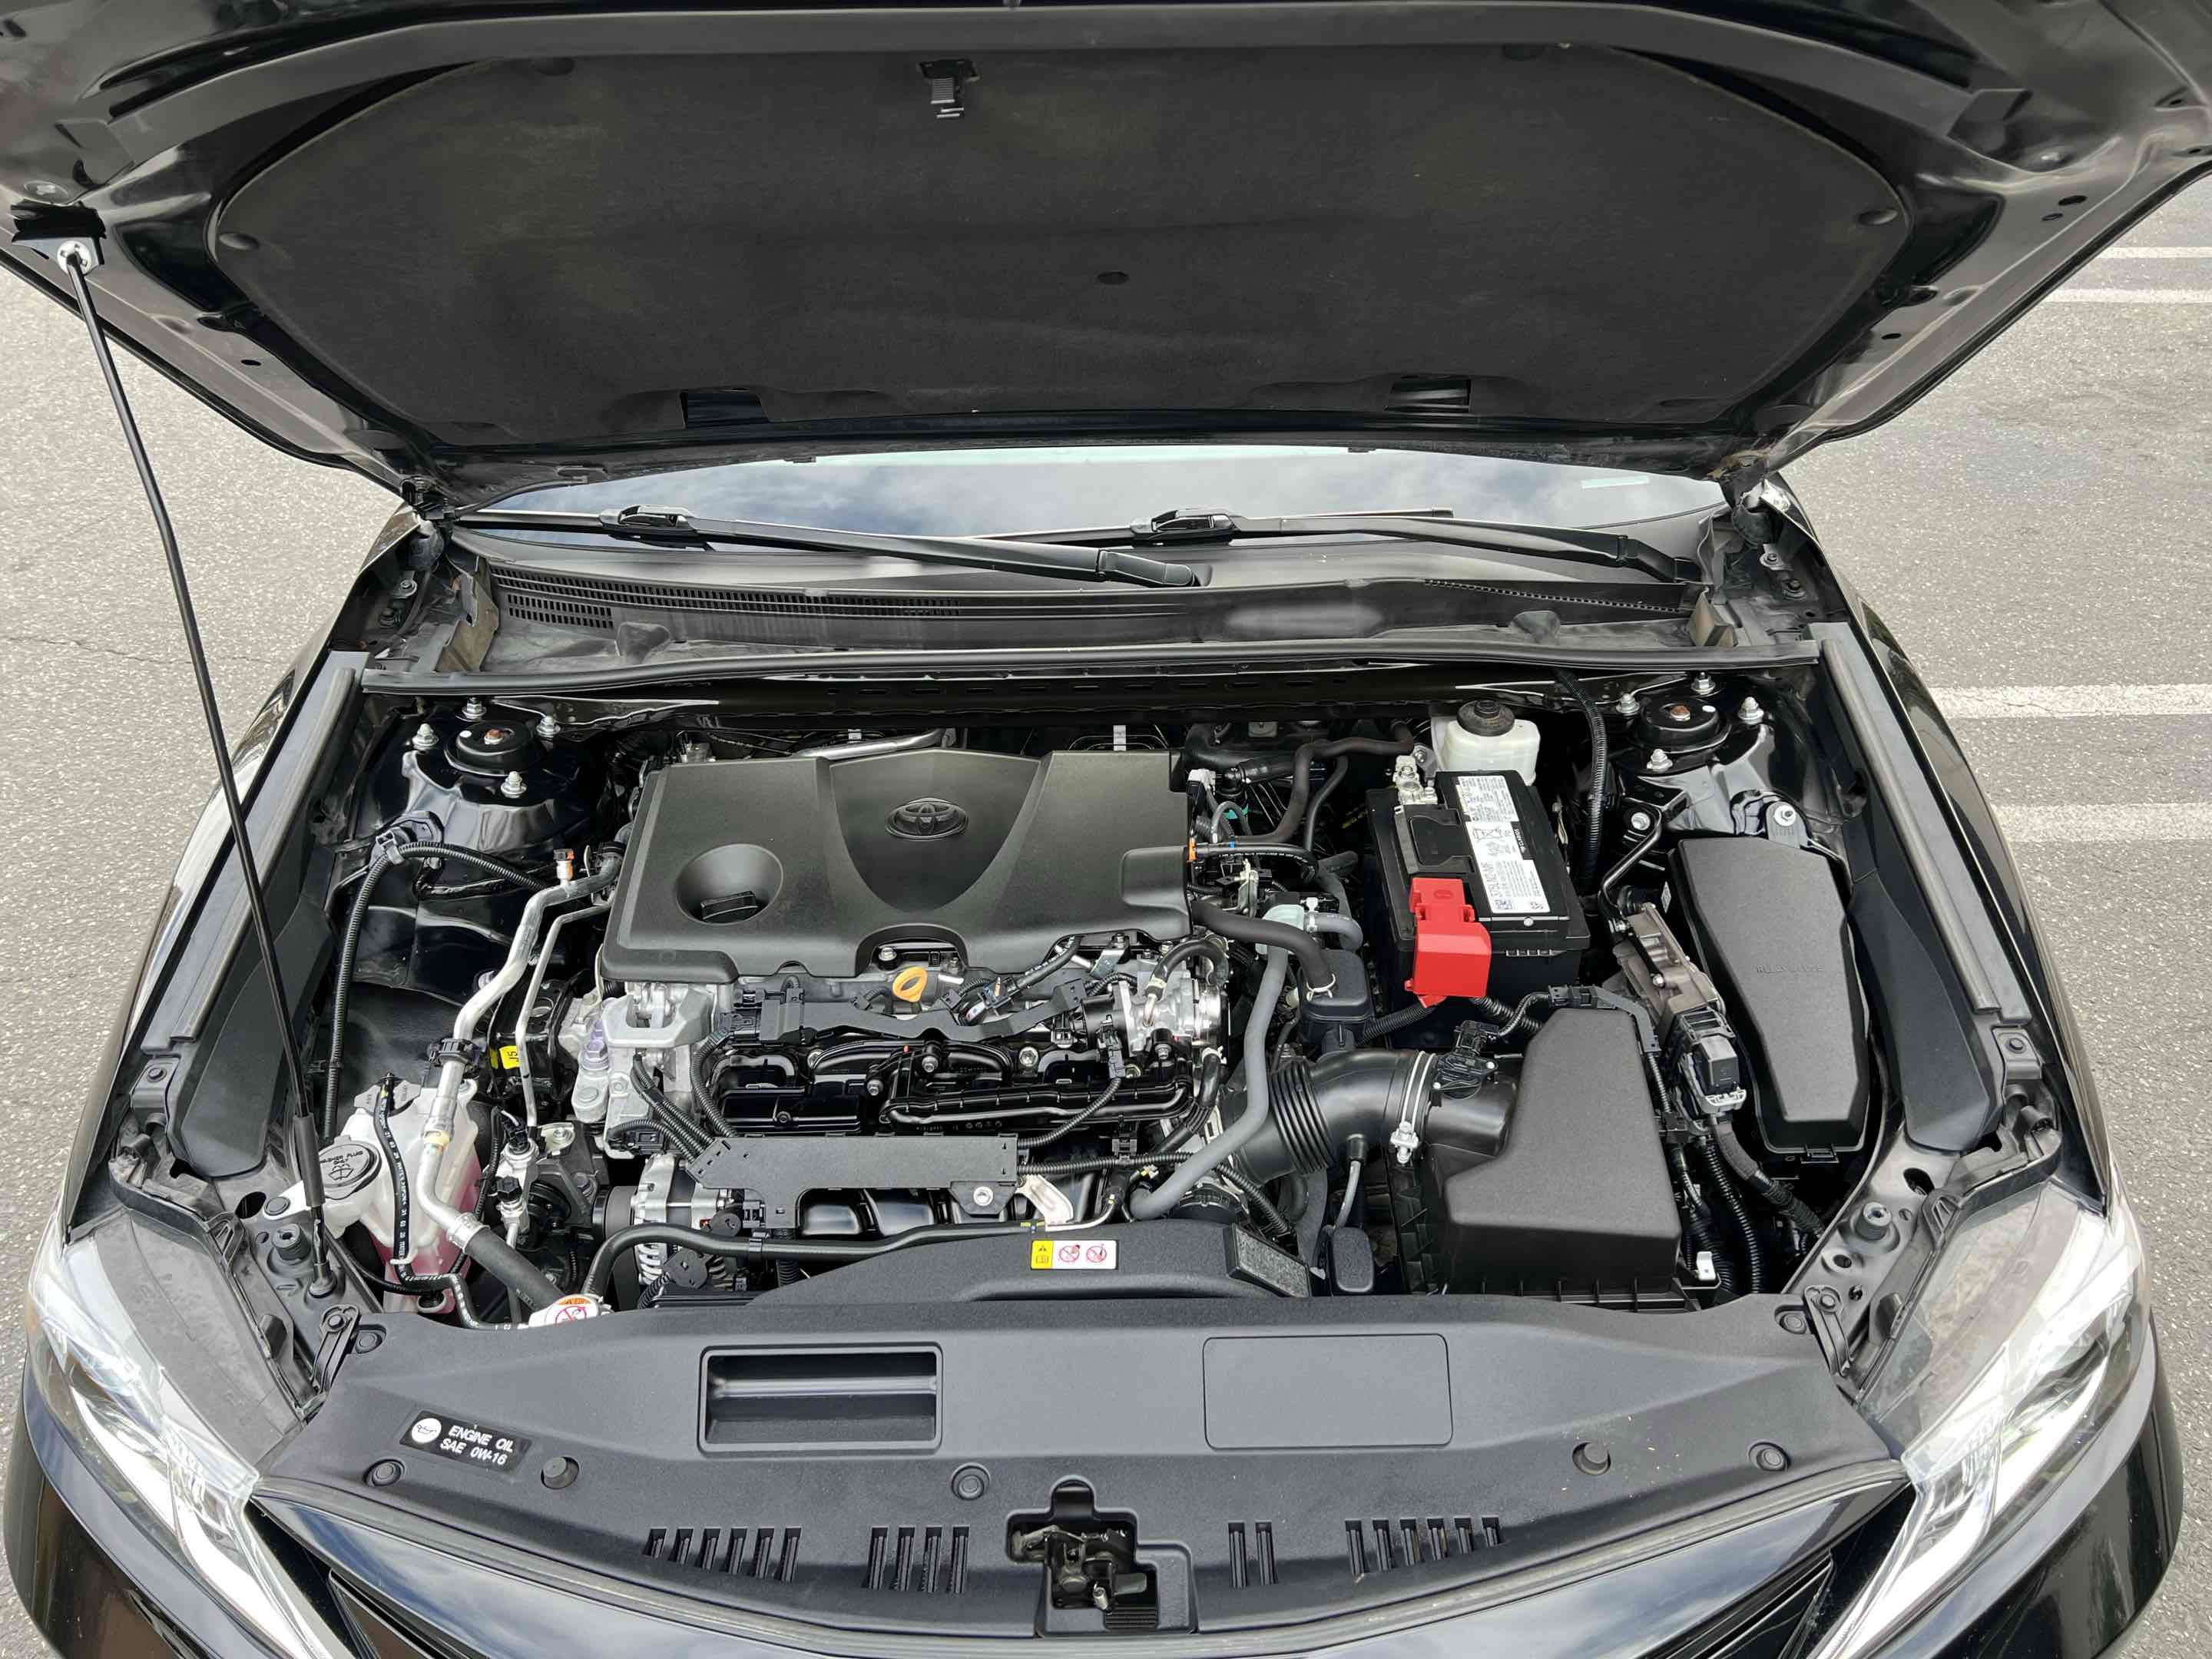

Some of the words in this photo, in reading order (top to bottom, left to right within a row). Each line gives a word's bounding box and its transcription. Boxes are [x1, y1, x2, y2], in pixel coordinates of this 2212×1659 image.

[440, 1438, 466, 1453] SAE
[471, 1447, 508, 1465] 0W-16
[449, 1425, 492, 1445] ENGINE
[495, 1439, 514, 1452] OIL
